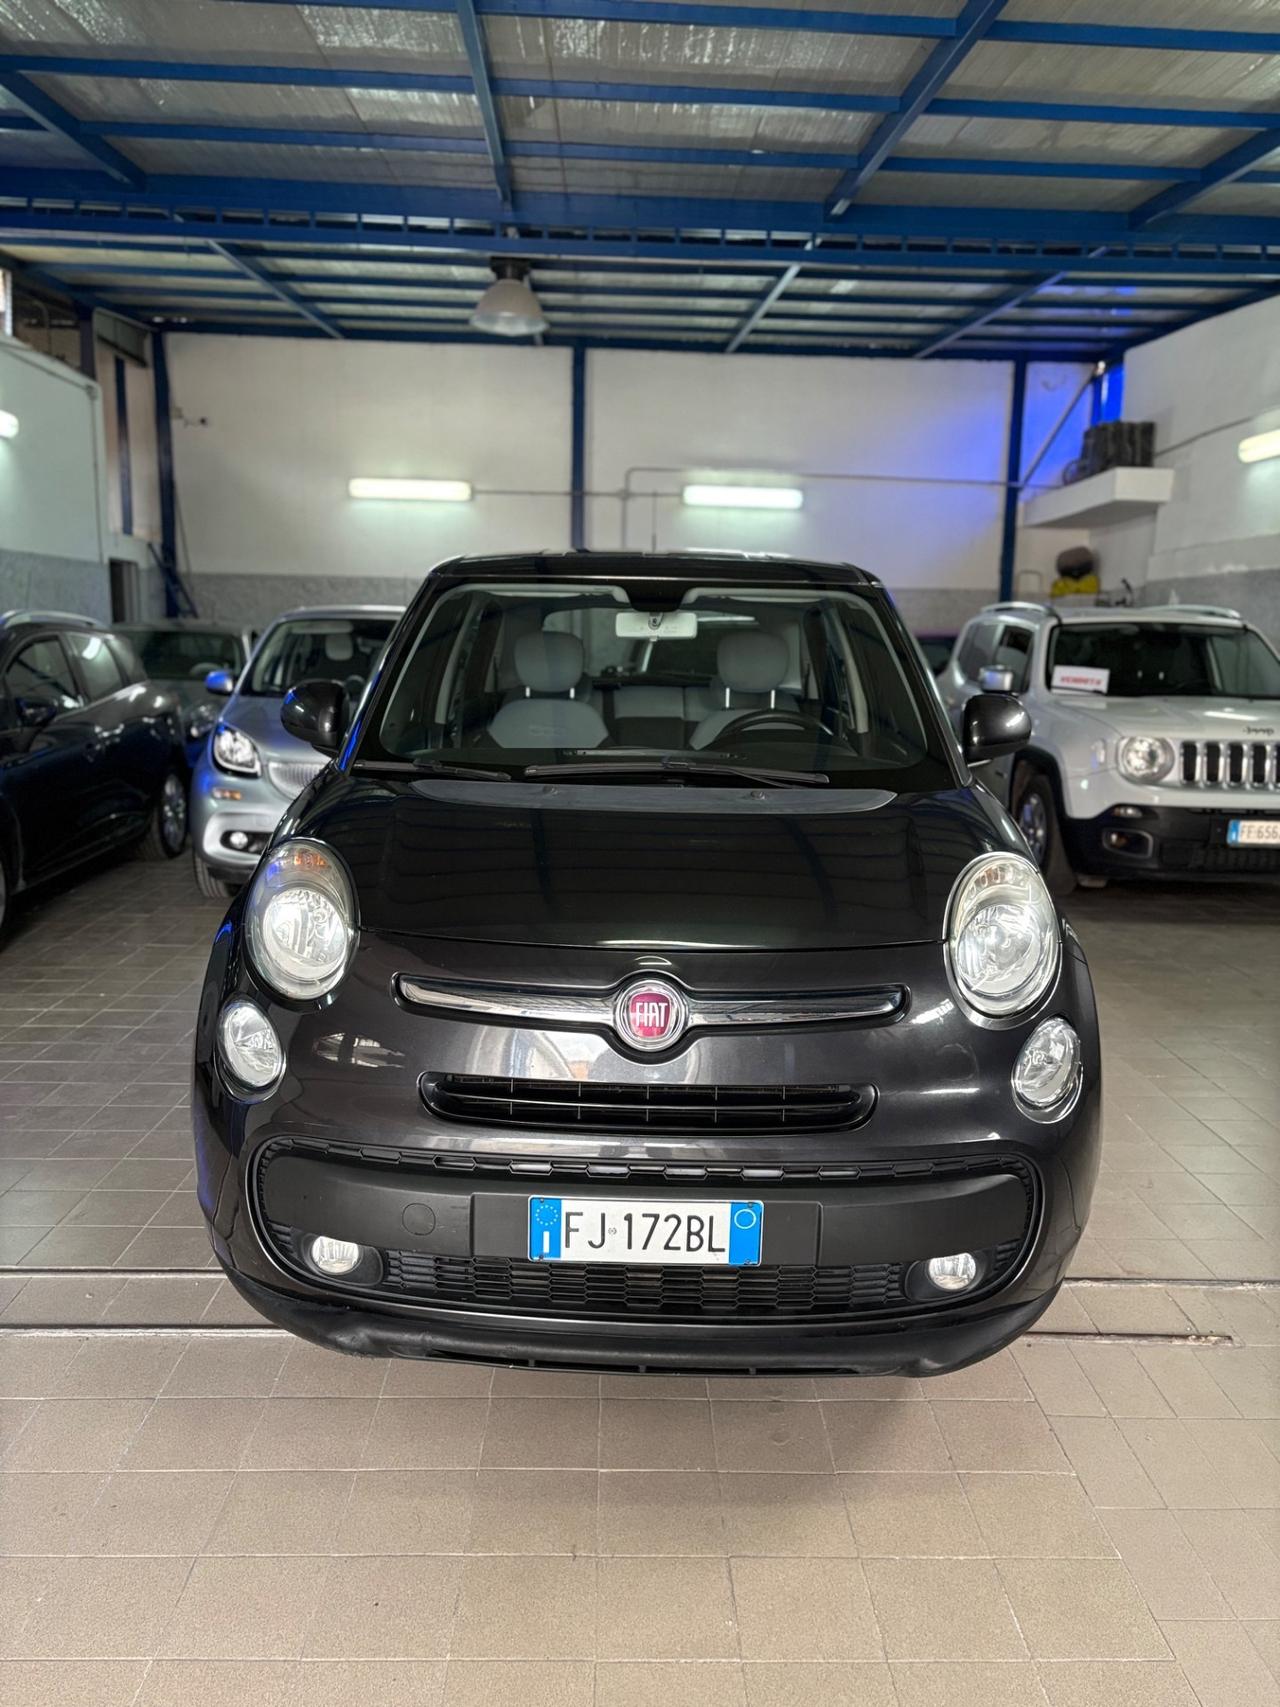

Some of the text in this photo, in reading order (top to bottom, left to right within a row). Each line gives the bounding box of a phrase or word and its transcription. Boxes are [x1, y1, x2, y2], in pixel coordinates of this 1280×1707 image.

[1257, 825, 1280, 840] 656
[635, 1002, 668, 1028] FIAT
[623, 1212, 726, 1253] 172BL
